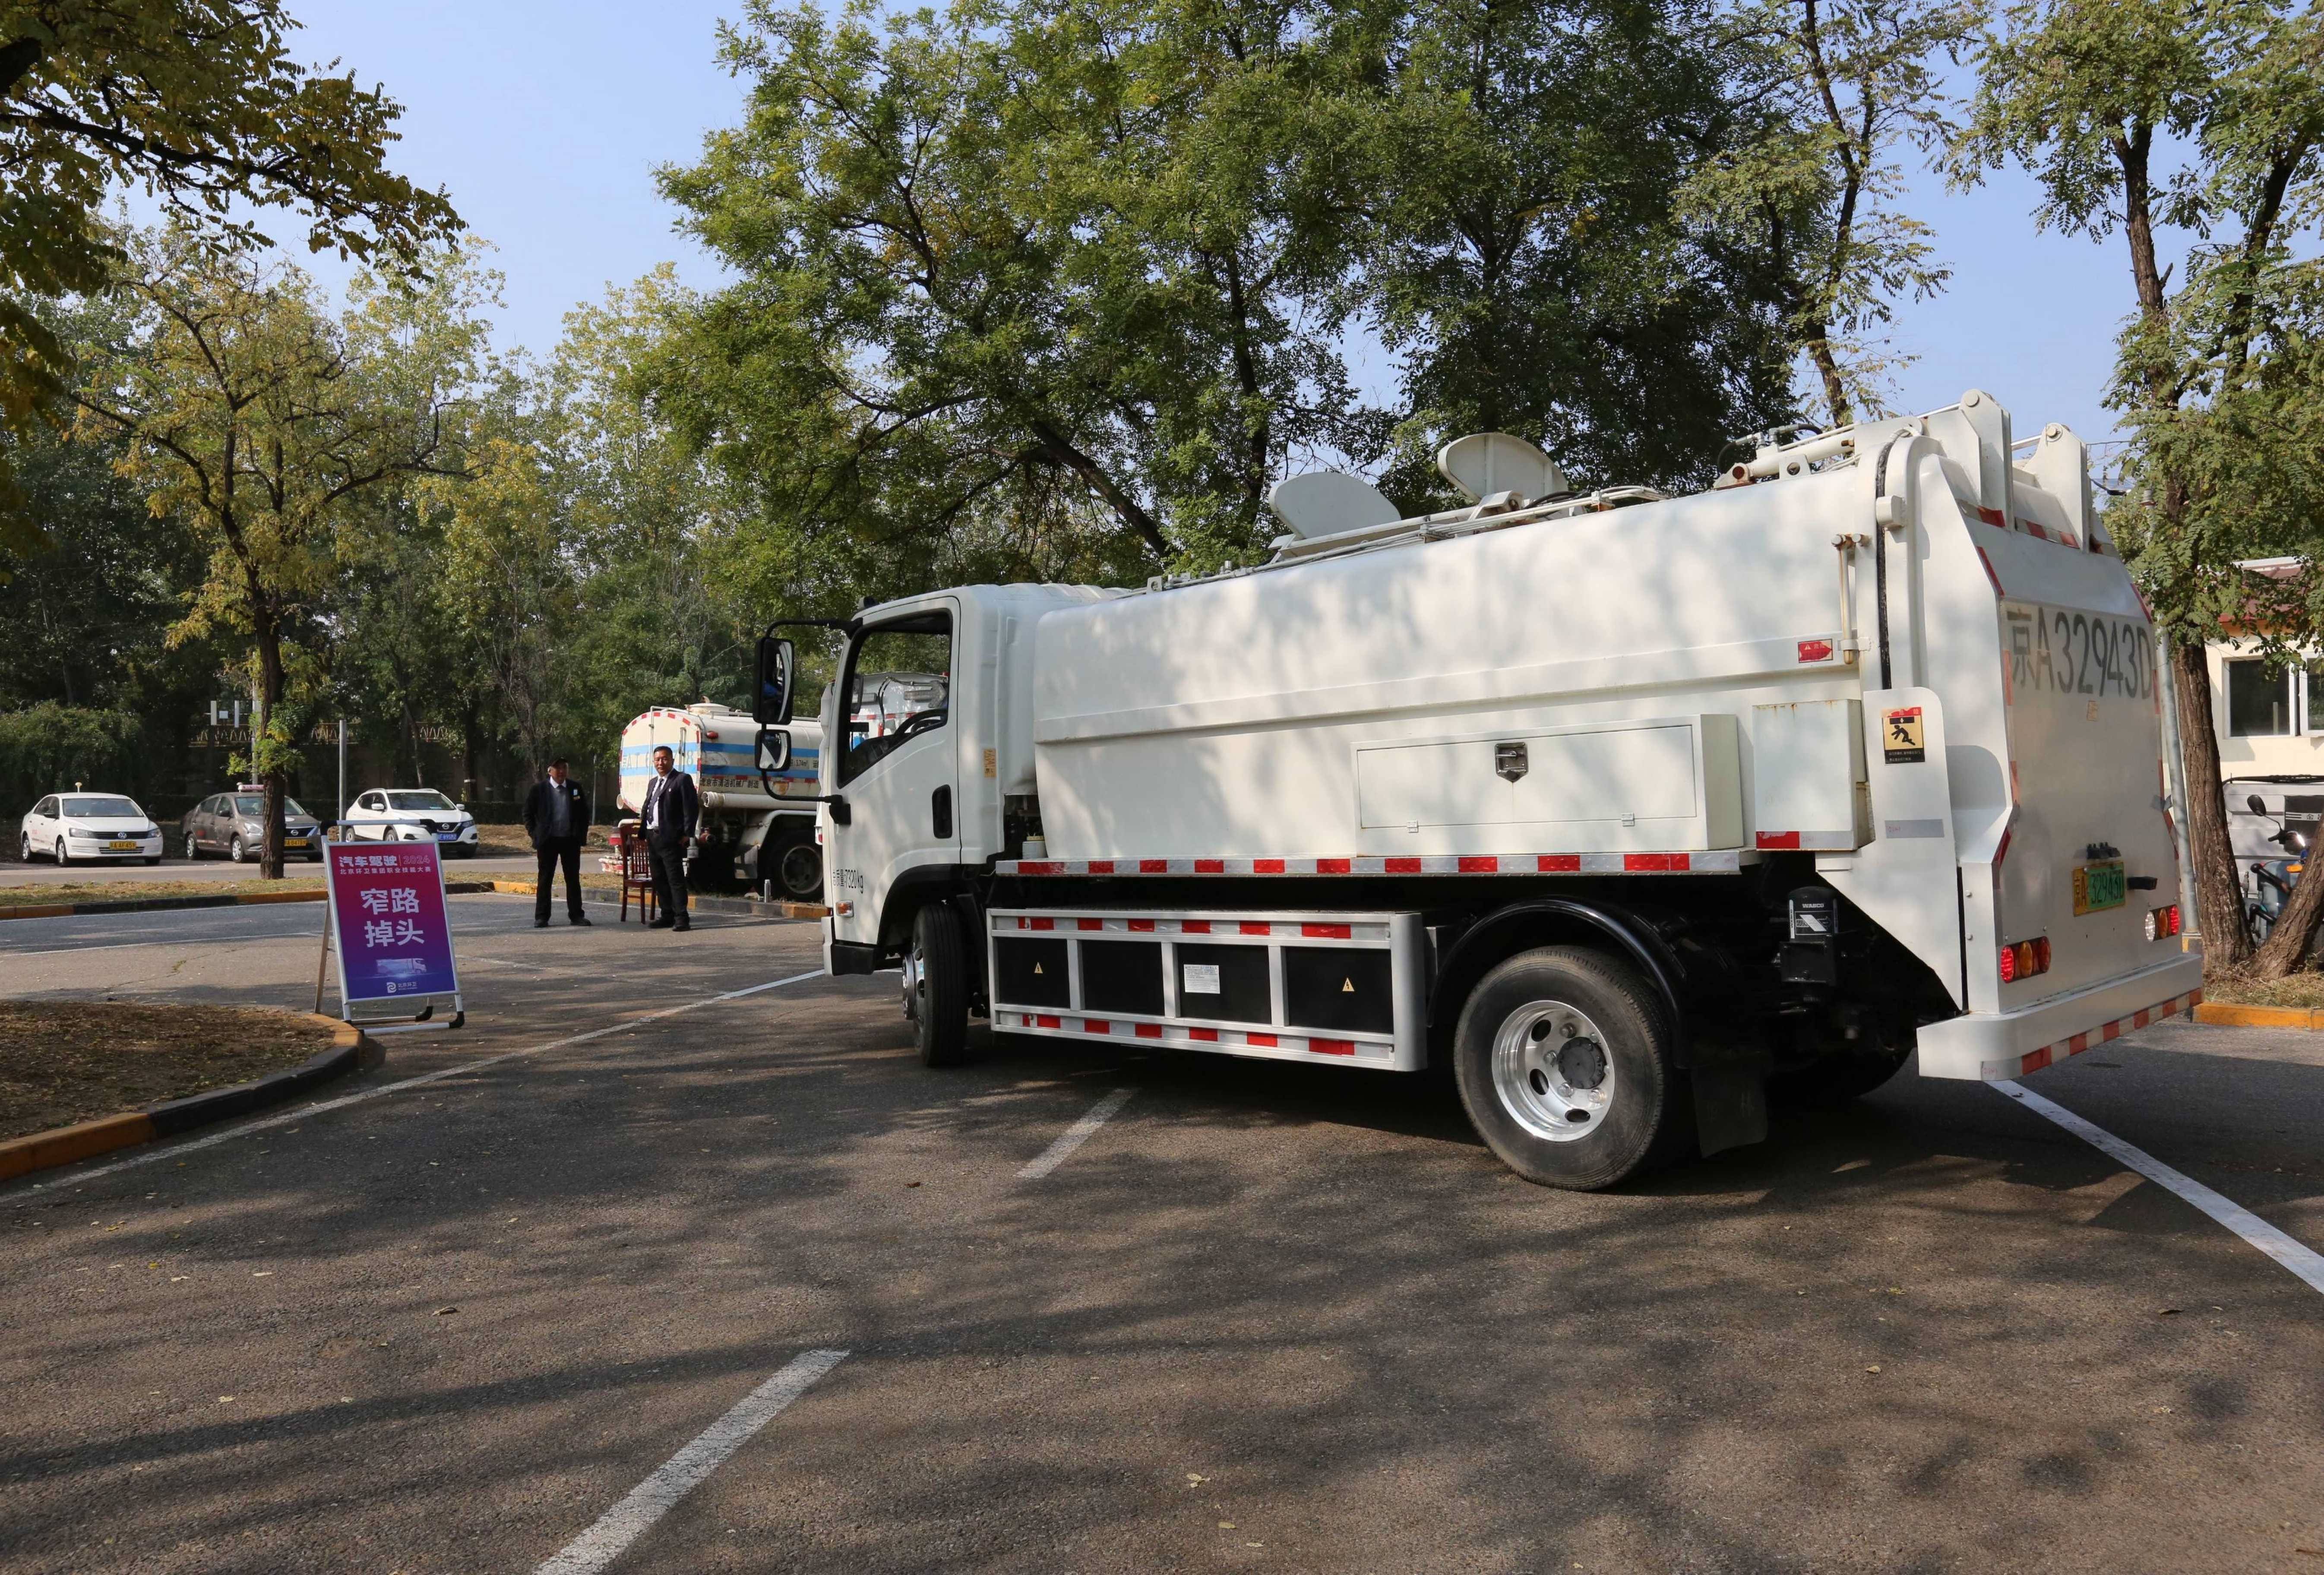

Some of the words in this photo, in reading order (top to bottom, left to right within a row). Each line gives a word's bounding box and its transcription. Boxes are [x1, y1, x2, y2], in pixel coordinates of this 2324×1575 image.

[2007, 607, 2152, 699] 京A32943D
[338, 856, 398, 867] 汽车驾驶
[403, 854, 431, 864] 2024
[340, 866, 431, 875] 北京环卫集团职业技能大赛
[360, 887, 420, 915] 窄路
[364, 918, 424, 948] 掉头
